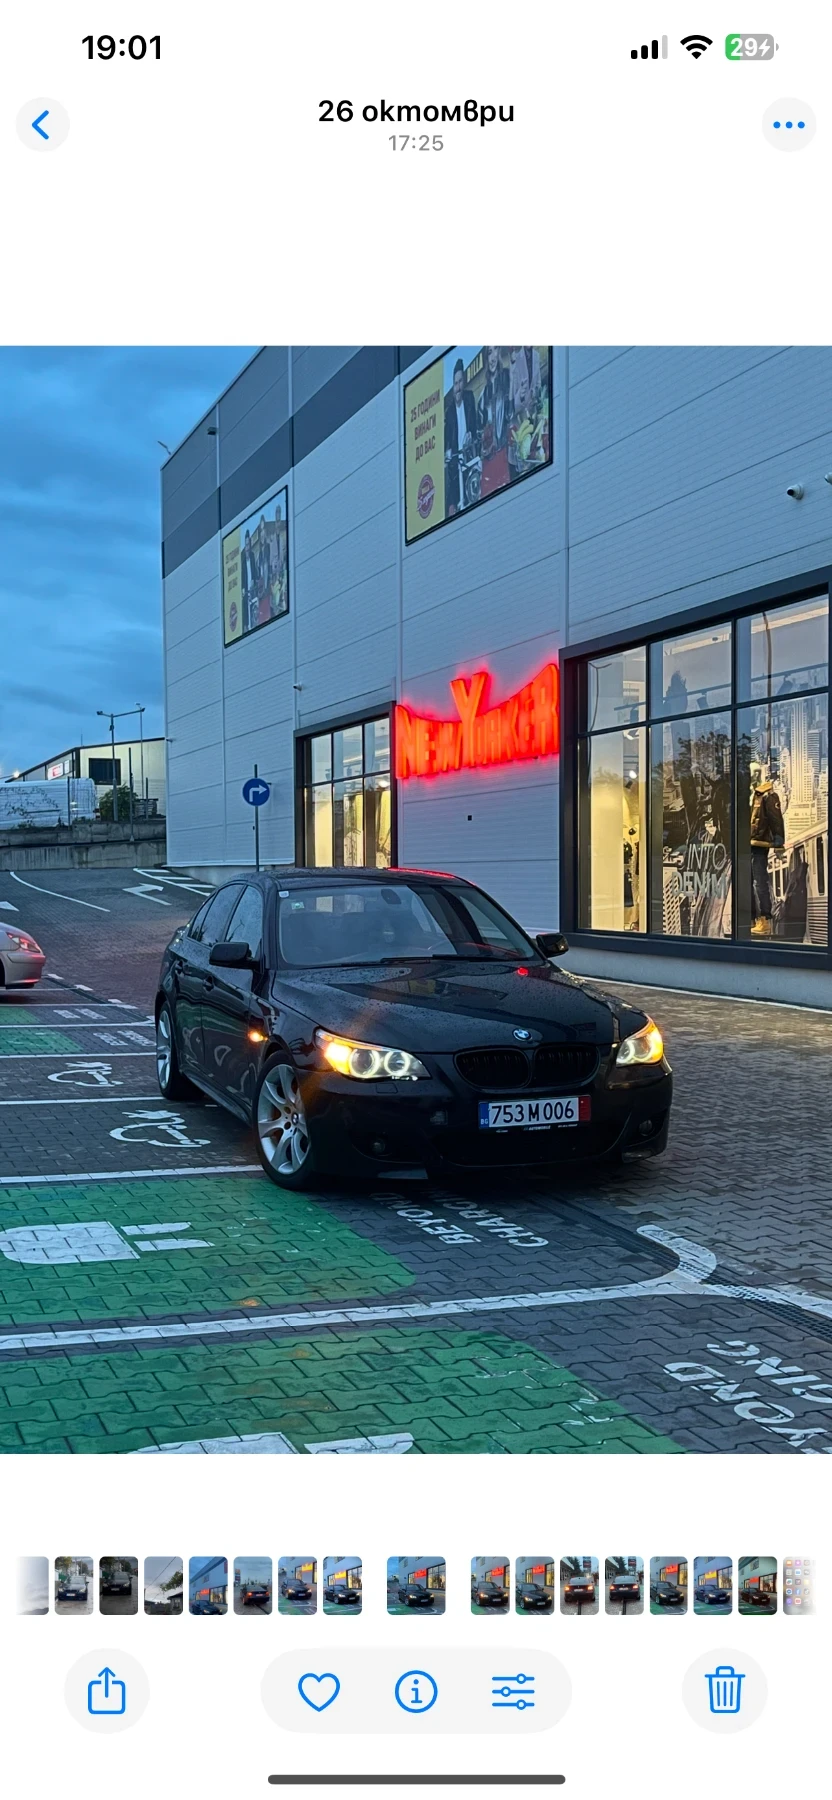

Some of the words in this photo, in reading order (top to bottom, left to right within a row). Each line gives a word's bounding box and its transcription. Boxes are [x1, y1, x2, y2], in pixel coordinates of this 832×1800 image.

[410, 406, 418, 422] 25
[414, 415, 437, 441] ВИНАГИ
[415, 444, 424, 464] ДО
[424, 435, 436, 456] ВАС
[687, 843, 727, 870] INTO
[672, 871, 728, 898] DENIM
[663, 1362, 832, 1454] YOND
